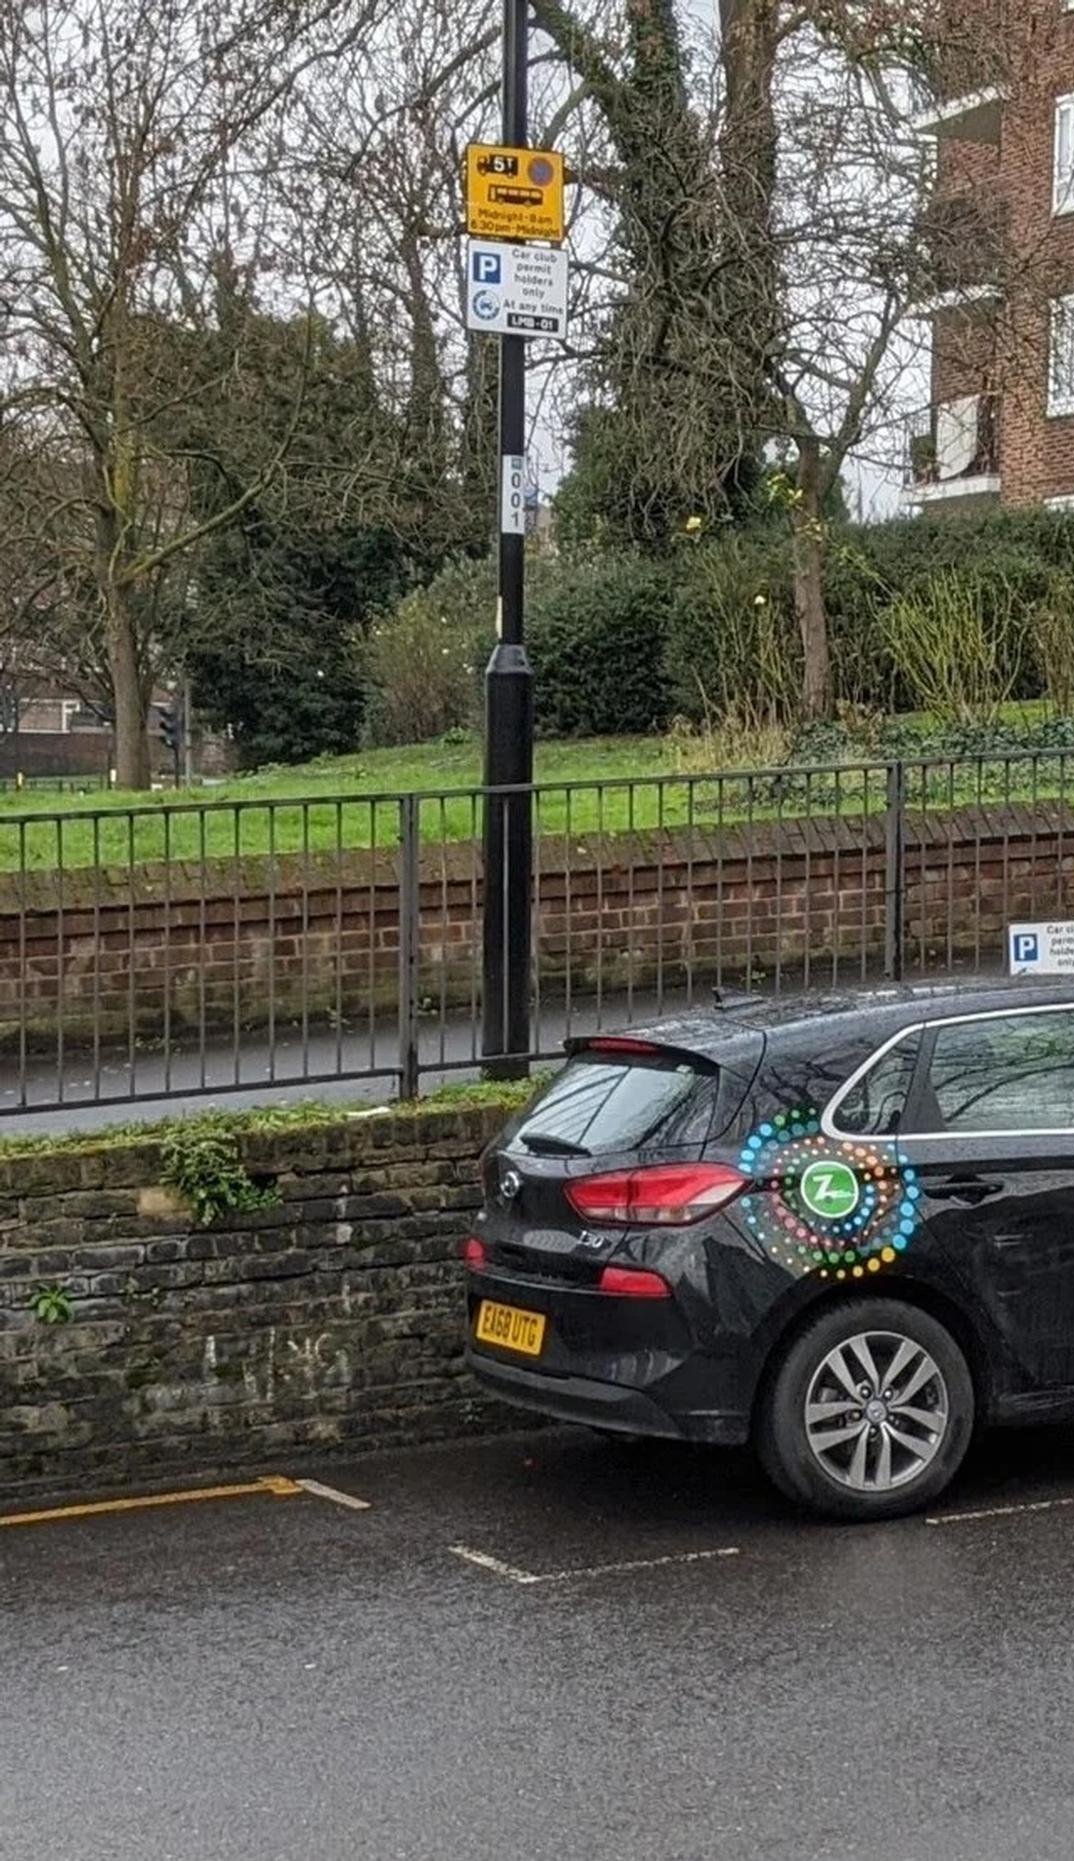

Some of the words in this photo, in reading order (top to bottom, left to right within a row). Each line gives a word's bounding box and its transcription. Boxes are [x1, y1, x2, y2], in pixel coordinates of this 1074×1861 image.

[494, 155, 514, 173] 5T
[512, 248, 530, 259] Car
[534, 252, 558, 263] club
[479, 255, 498, 280] P
[516, 262, 552, 275] permit
[514, 272, 553, 287] holders
[522, 287, 545, 299] only
[503, 298, 515, 310] At
[519, 302, 537, 313] any
[541, 303, 564, 315] time
[1047, 925, 1064, 934] Car
[1018, 936, 1035, 960] P
[511, 1312, 538, 1347] UTG
